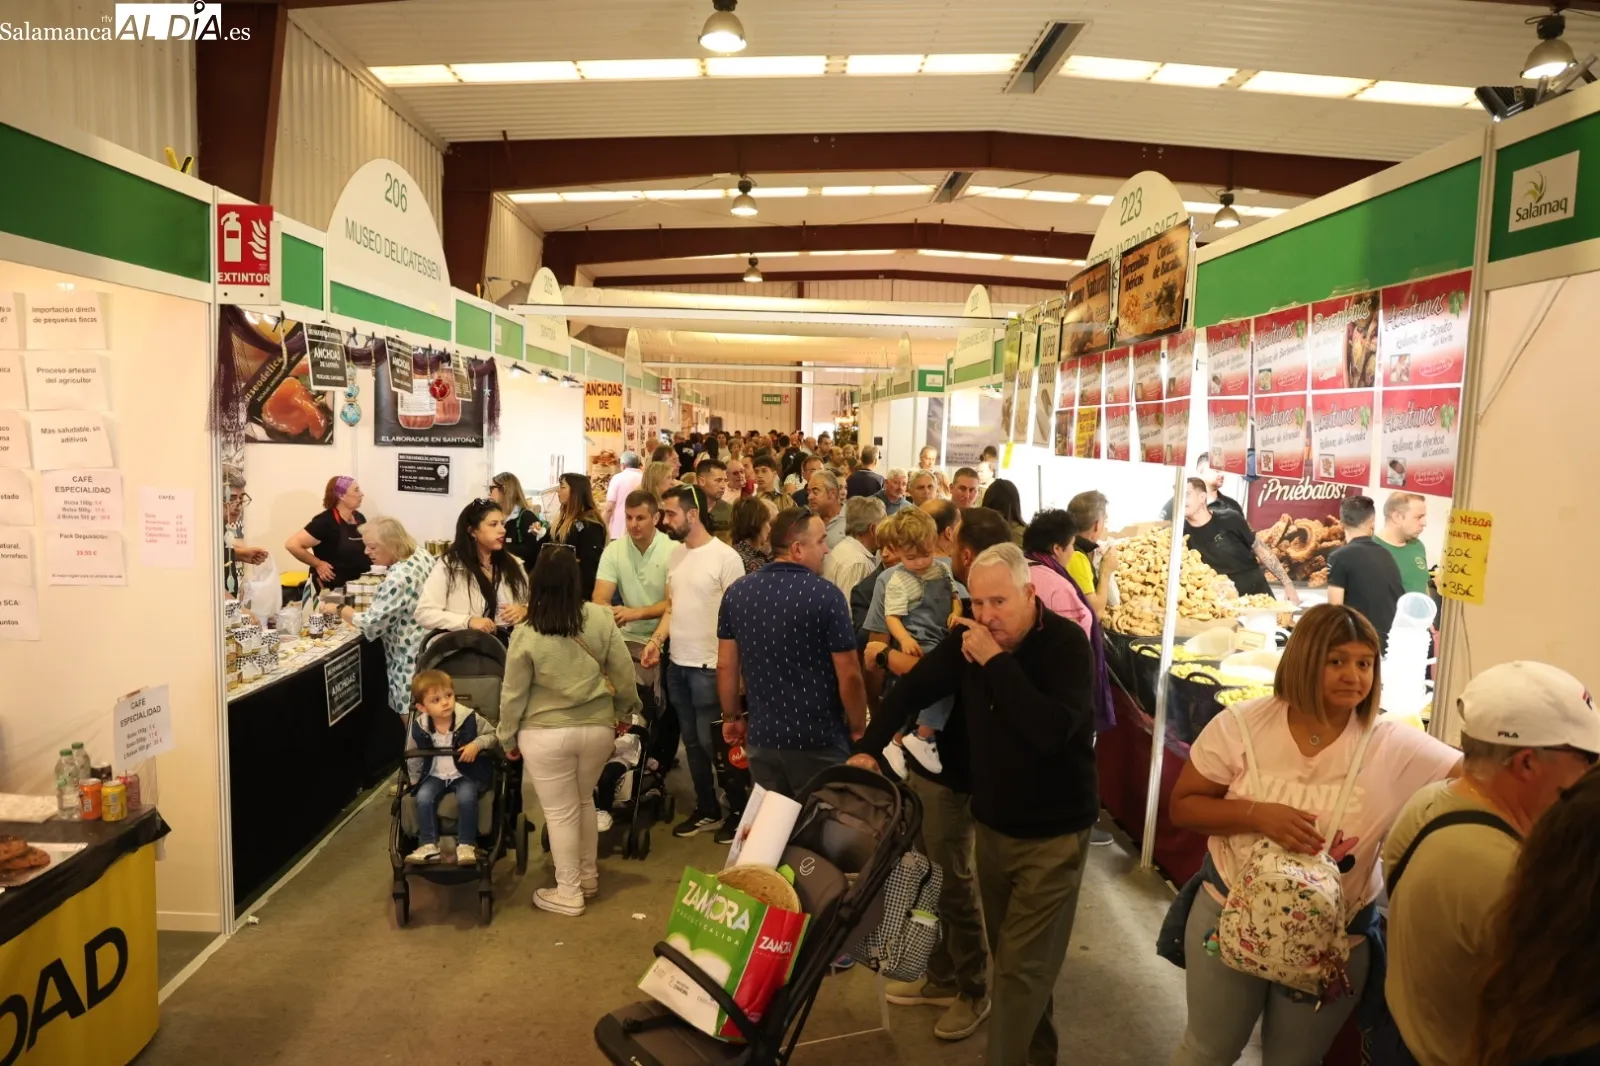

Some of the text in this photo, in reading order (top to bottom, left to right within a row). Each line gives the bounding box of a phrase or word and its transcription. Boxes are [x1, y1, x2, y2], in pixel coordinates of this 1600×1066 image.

[384, 172, 408, 213] 206
[1119, 186, 1143, 226] 223
[1515, 197, 1568, 222] Salamaq
[345, 217, 442, 282] MUSEO DELICATESSEN
[218, 272, 271, 283] EXTINTOR
[32, 306, 74, 314] Importación
[1384, 292, 1447, 332] Aceitunas
[314, 347, 341, 361] ANCHOAS
[59, 378, 92, 386] agricultor
[585, 383, 622, 397] ANCHOAS
[599, 399, 609, 410] DE
[585, 414, 622, 432] SANTOÑA
[1383, 399, 1439, 434] Aceitunas
[381, 435, 430, 443] ELABORADAS
[72, 475, 93, 483] CAFÉ
[54, 486, 111, 494] ESPECIALIDAD
[1257, 476, 1348, 508] ¡Pruébalos!
[332, 672, 356, 697] ANCHOAS
[120, 705, 162, 728] ESPECIALIDAD
[681, 880, 751, 934] ZAMORA
